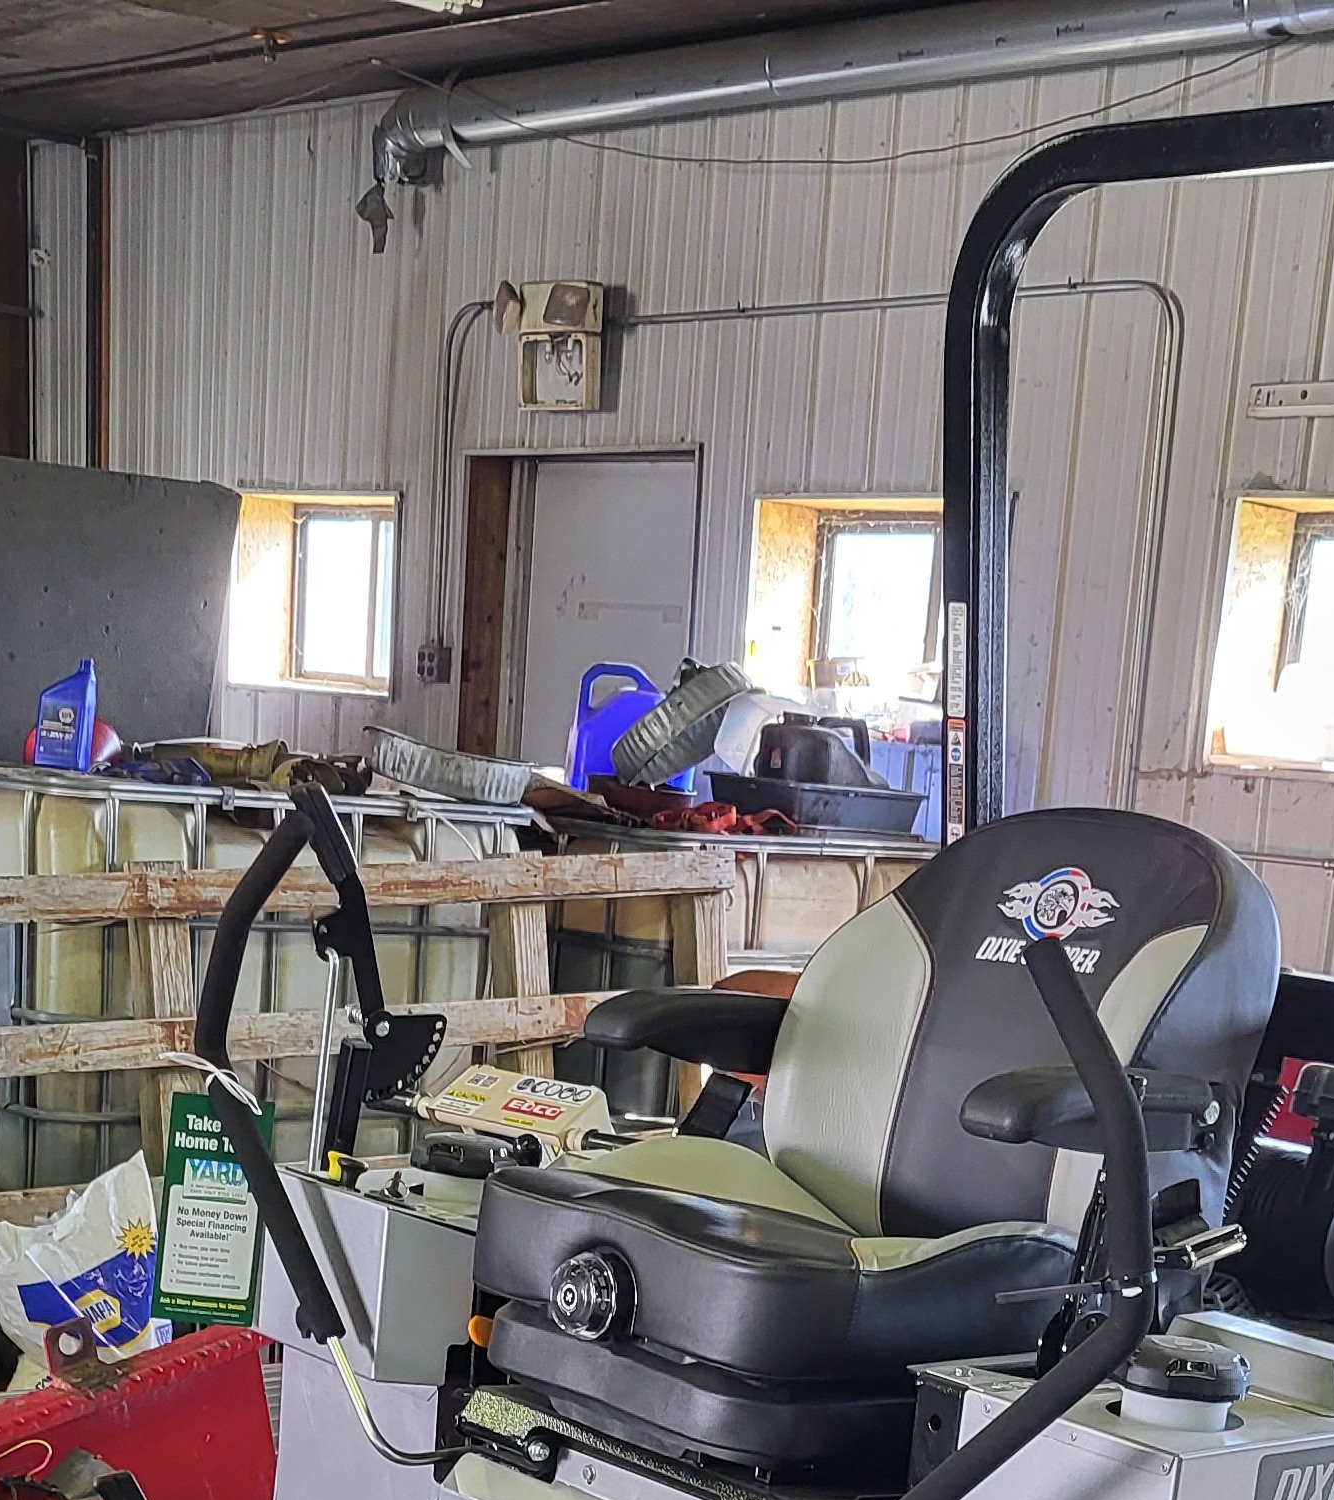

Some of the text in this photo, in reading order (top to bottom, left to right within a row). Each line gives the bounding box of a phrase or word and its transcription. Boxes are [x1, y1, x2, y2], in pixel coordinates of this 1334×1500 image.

[975, 936, 1027, 964] DIXIE
[508, 1100, 561, 1116] EDCO
[186, 1114, 222, 1133] Take
[174, 1131, 218, 1151] Home
[178, 1206, 248, 1222] No Money Down
[176, 1218, 247, 1233] Special Financing
